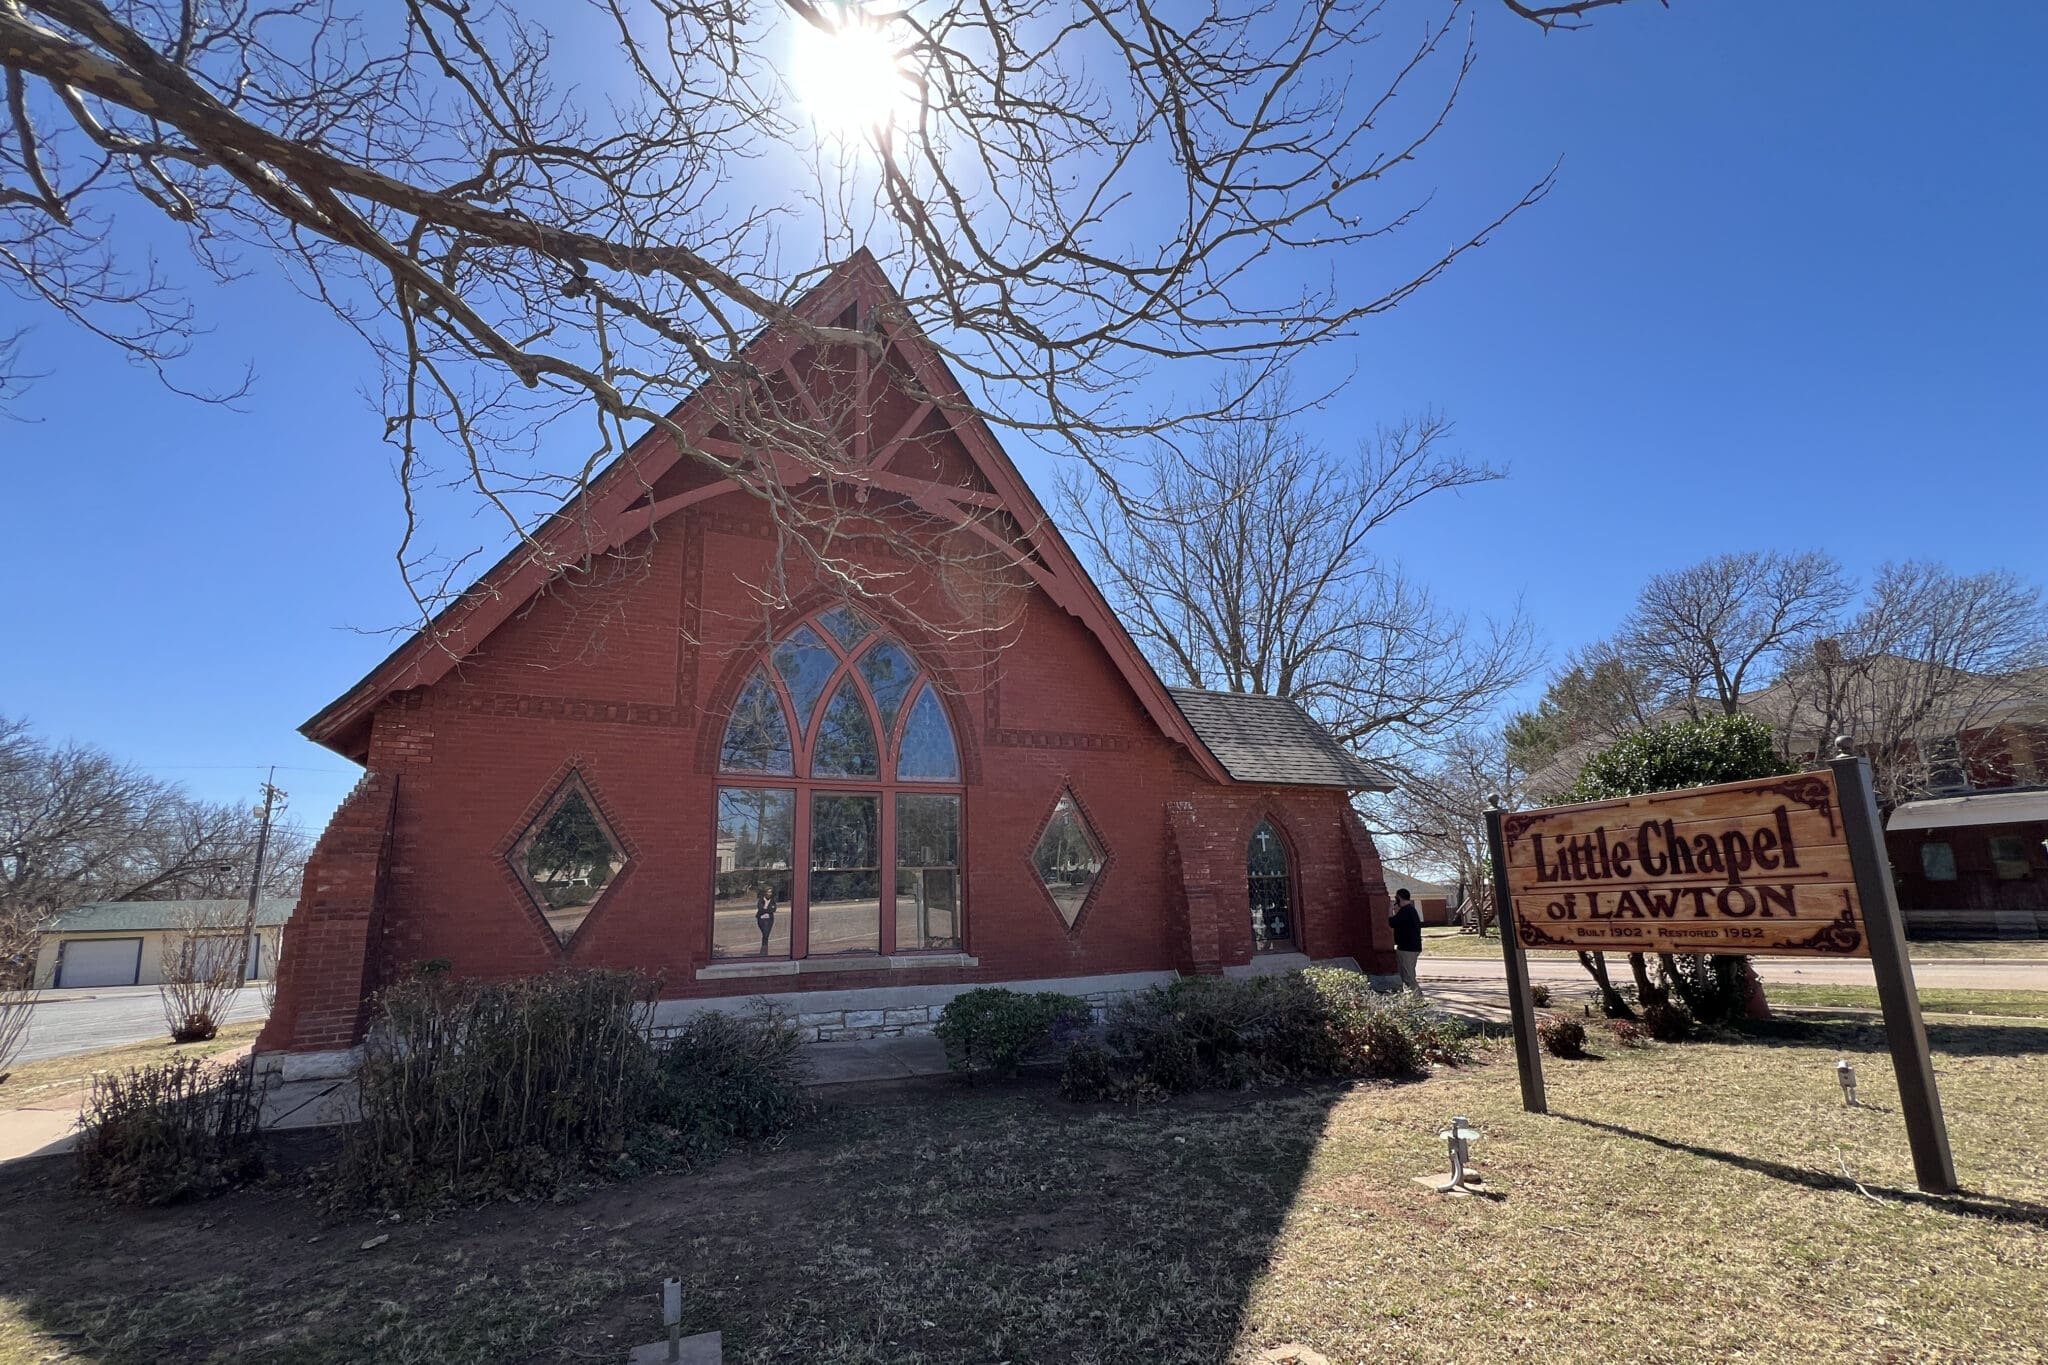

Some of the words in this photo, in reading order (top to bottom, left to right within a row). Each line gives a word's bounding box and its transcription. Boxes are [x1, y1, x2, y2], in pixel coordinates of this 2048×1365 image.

[1531, 827, 1632, 883] Little
[1637, 805, 1799, 886] Chapel
[1546, 893, 1579, 921] of
[1589, 883, 1799, 919] LAWTON
[1609, 927, 1642, 937] 1902
[1724, 927, 1765, 938] 1982
